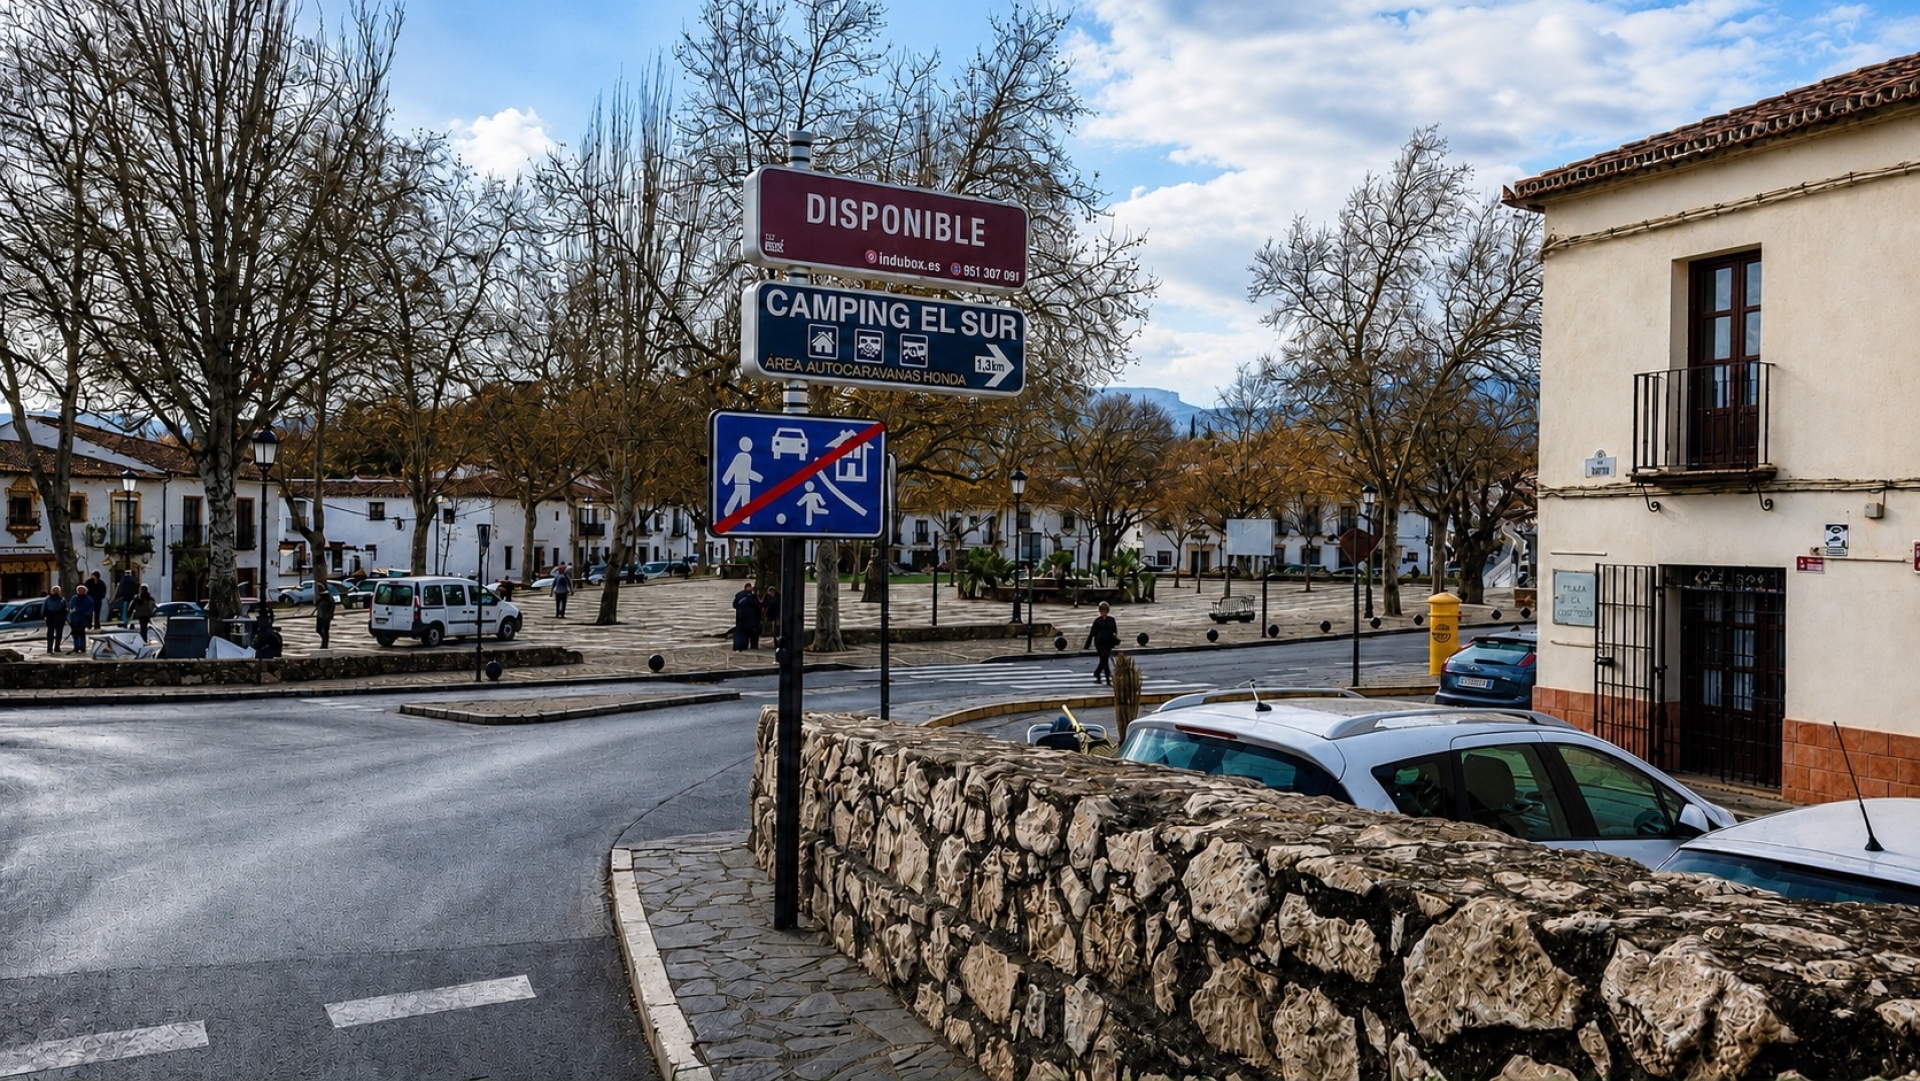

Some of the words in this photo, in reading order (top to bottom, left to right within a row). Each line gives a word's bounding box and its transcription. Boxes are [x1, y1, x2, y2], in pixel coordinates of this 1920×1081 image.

[807, 193, 985, 247] DISPONIBLE
[879, 252, 941, 272] indubox.es
[964, 265, 980, 278] 951
[983, 267, 1001, 279] 307
[1004, 270, 1020, 282] 091
[766, 289, 910, 330] CAMPING
[921, 306, 955, 334] EL
[960, 310, 1018, 341] SUR
[765, 353, 803, 372] ÁREA
[806, 360, 921, 382] AUTOCARAVANAS
[923, 370, 967, 386] HONDA
